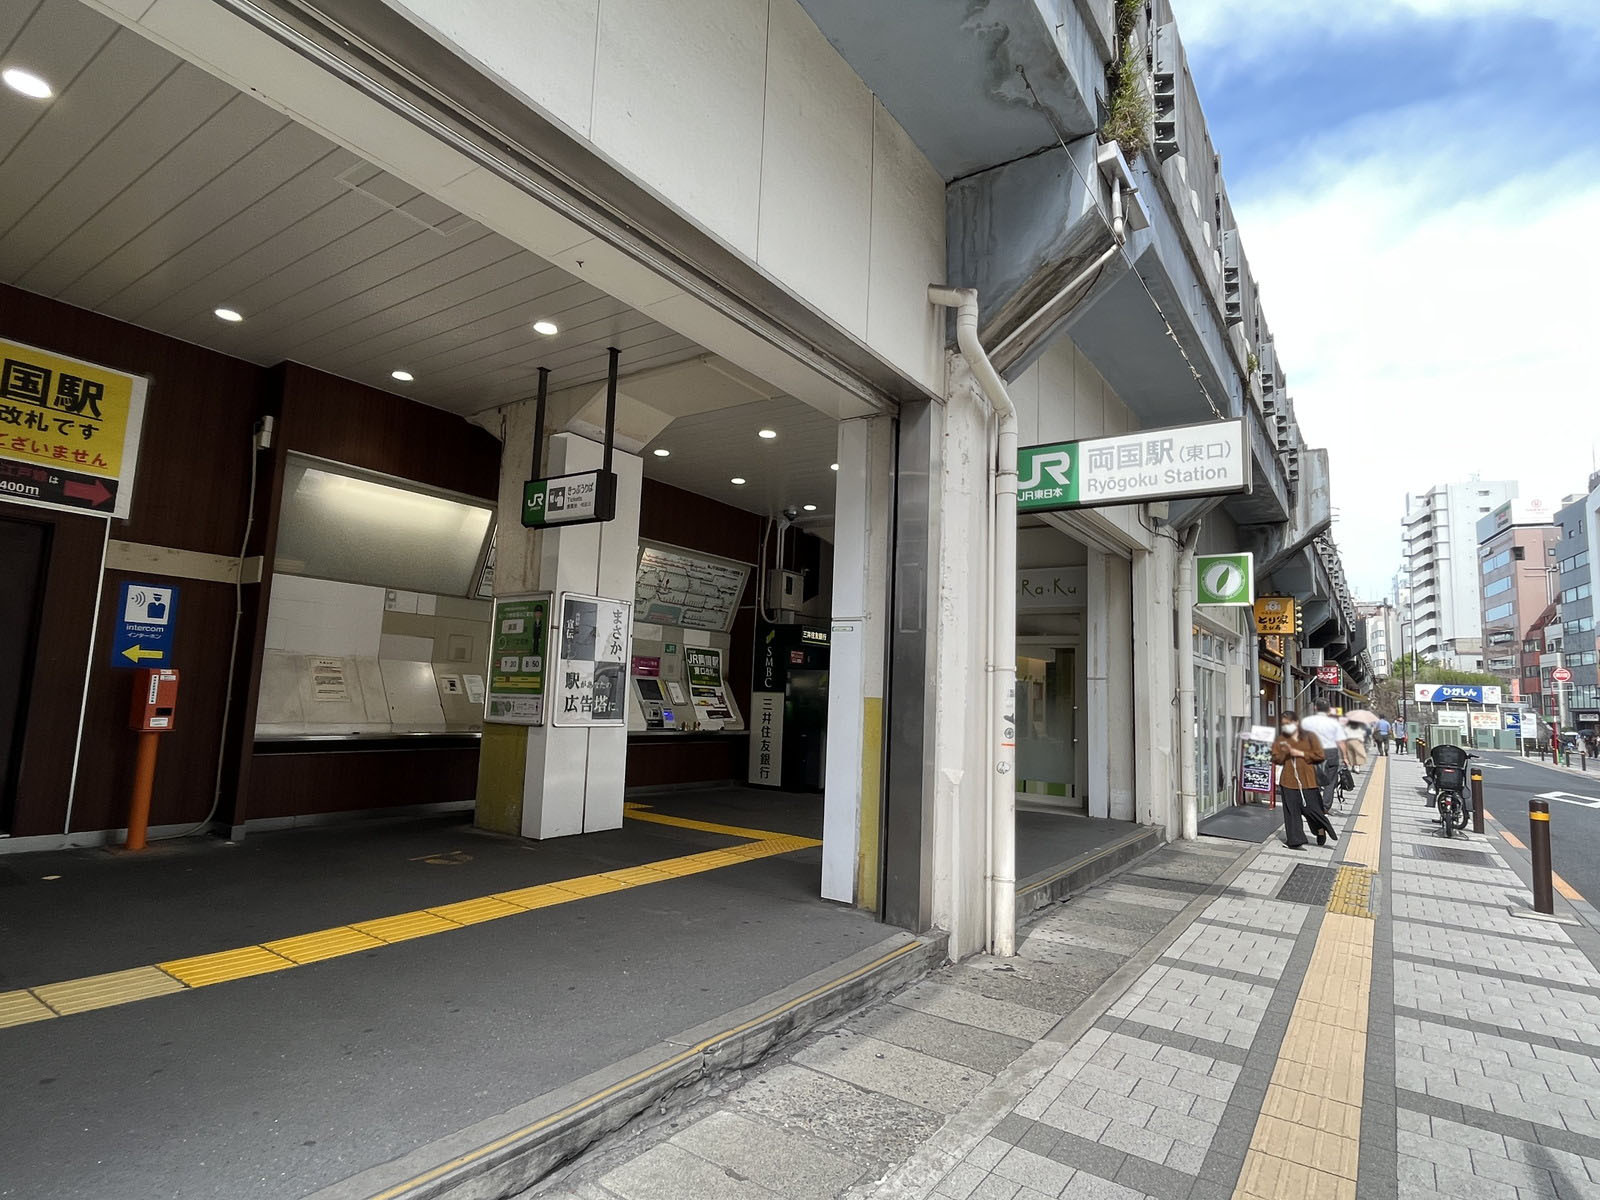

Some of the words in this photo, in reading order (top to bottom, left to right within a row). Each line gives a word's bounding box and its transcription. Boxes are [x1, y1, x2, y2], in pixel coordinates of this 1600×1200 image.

[0, 358, 105, 418] 国駅
[1017, 451, 1071, 489] JR
[1087, 472, 1158, 494] Ryōgoku
[1164, 465, 1228, 484] Station
[528, 493, 544, 506] JR
[1017, 487, 1063, 501] JR東日本
[126, 624, 164, 632] intercom
[1258, 613, 1289, 624] とり家
[764, 647, 774, 688] SMBC
[1442, 687, 1478, 697] ひがしん
[564, 694, 616, 713] 広告塔に
[760, 698, 773, 780] 三井住友銀行
